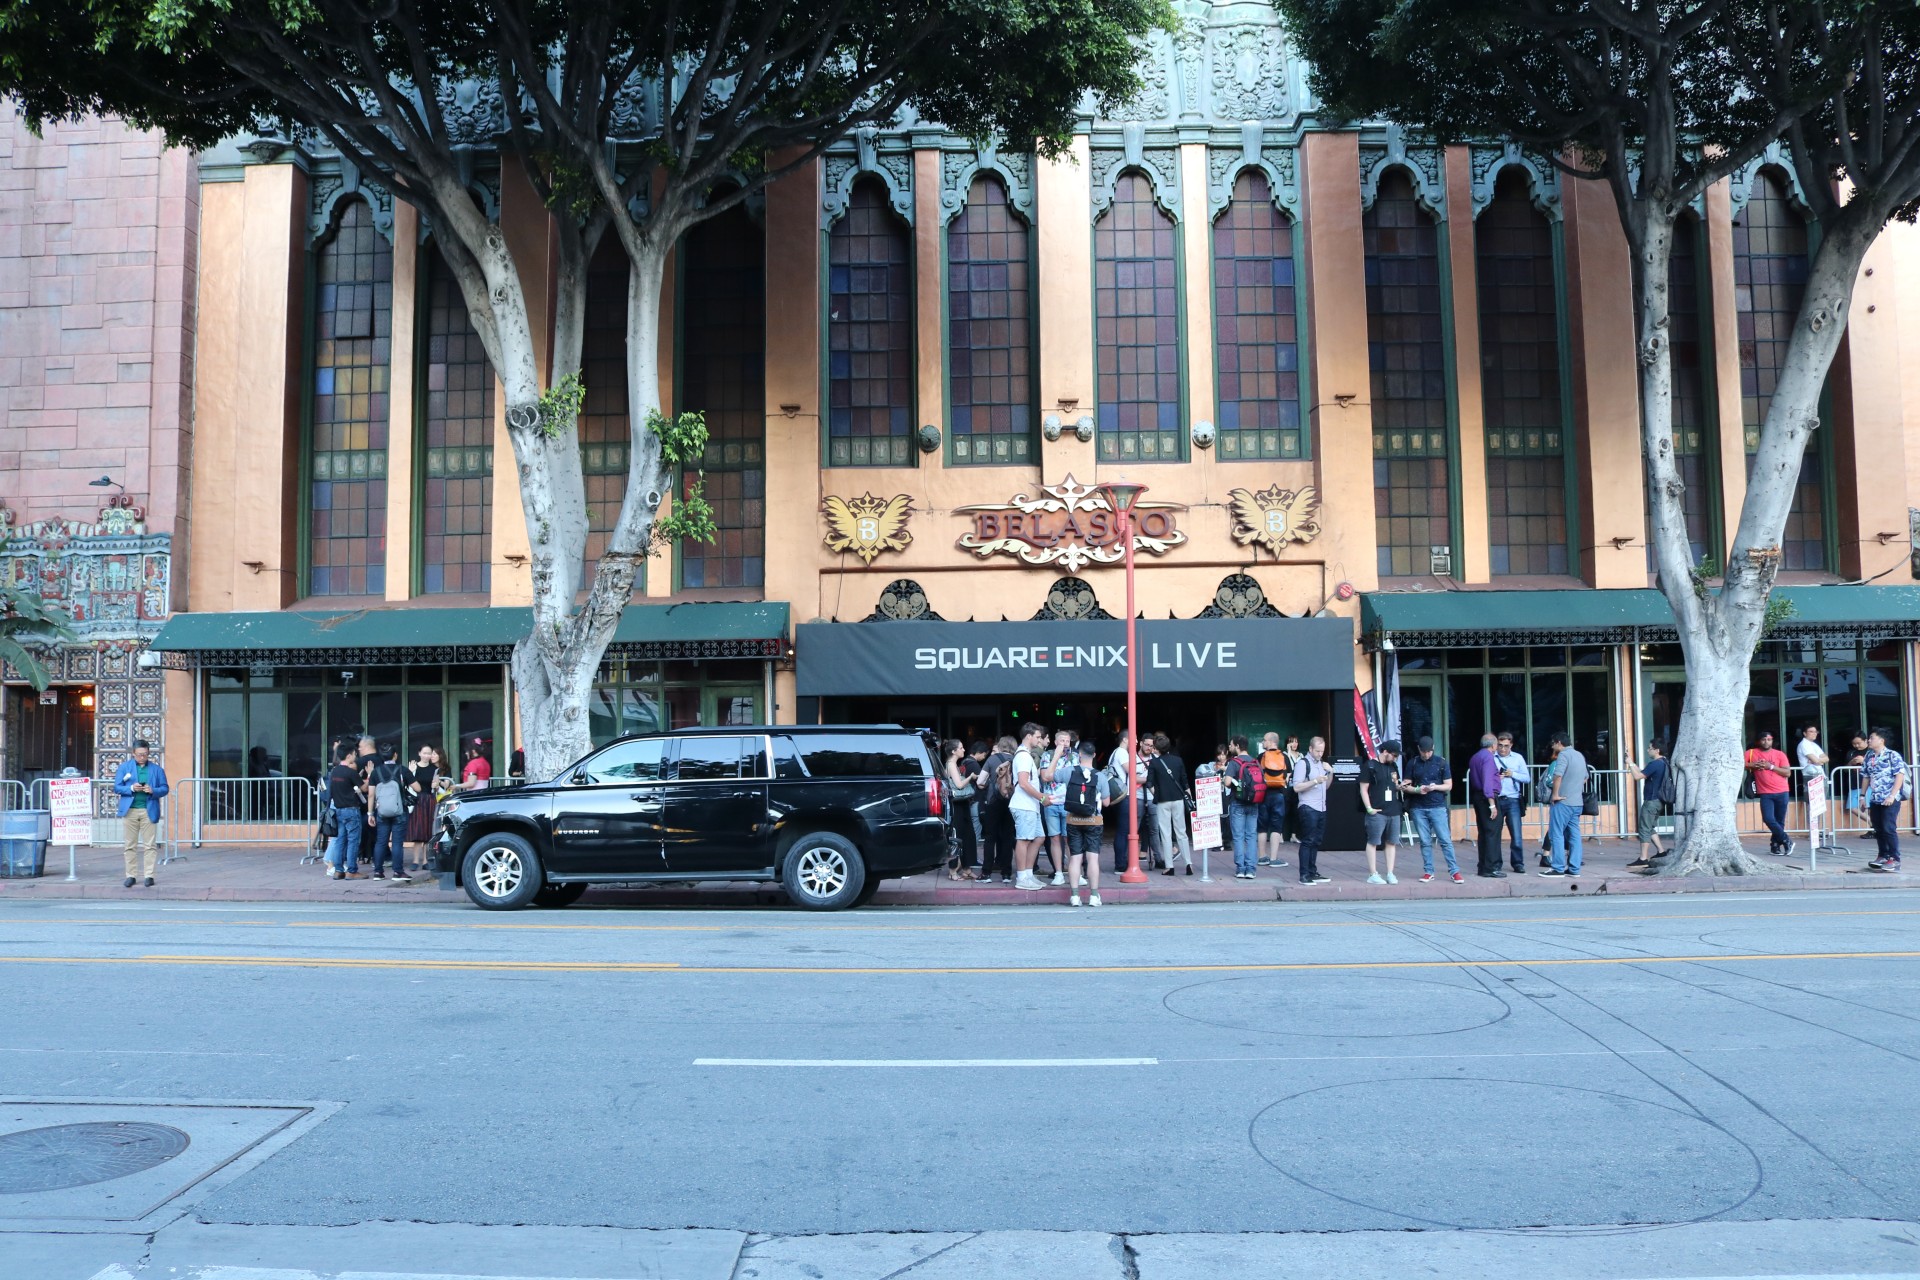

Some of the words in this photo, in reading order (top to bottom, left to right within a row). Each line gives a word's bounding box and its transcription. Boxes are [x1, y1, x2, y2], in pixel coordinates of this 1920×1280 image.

[914, 646, 1049, 671] SQUARE
[1055, 645, 1128, 668] ENIX
[1152, 642, 1237, 668] LIVE
[52, 789, 64, 799] NO
[56, 798, 87, 806] ANYTIME
[55, 818, 66, 827] NO
[67, 819, 90, 827] PARKING
[1193, 821, 1202, 832] NO
